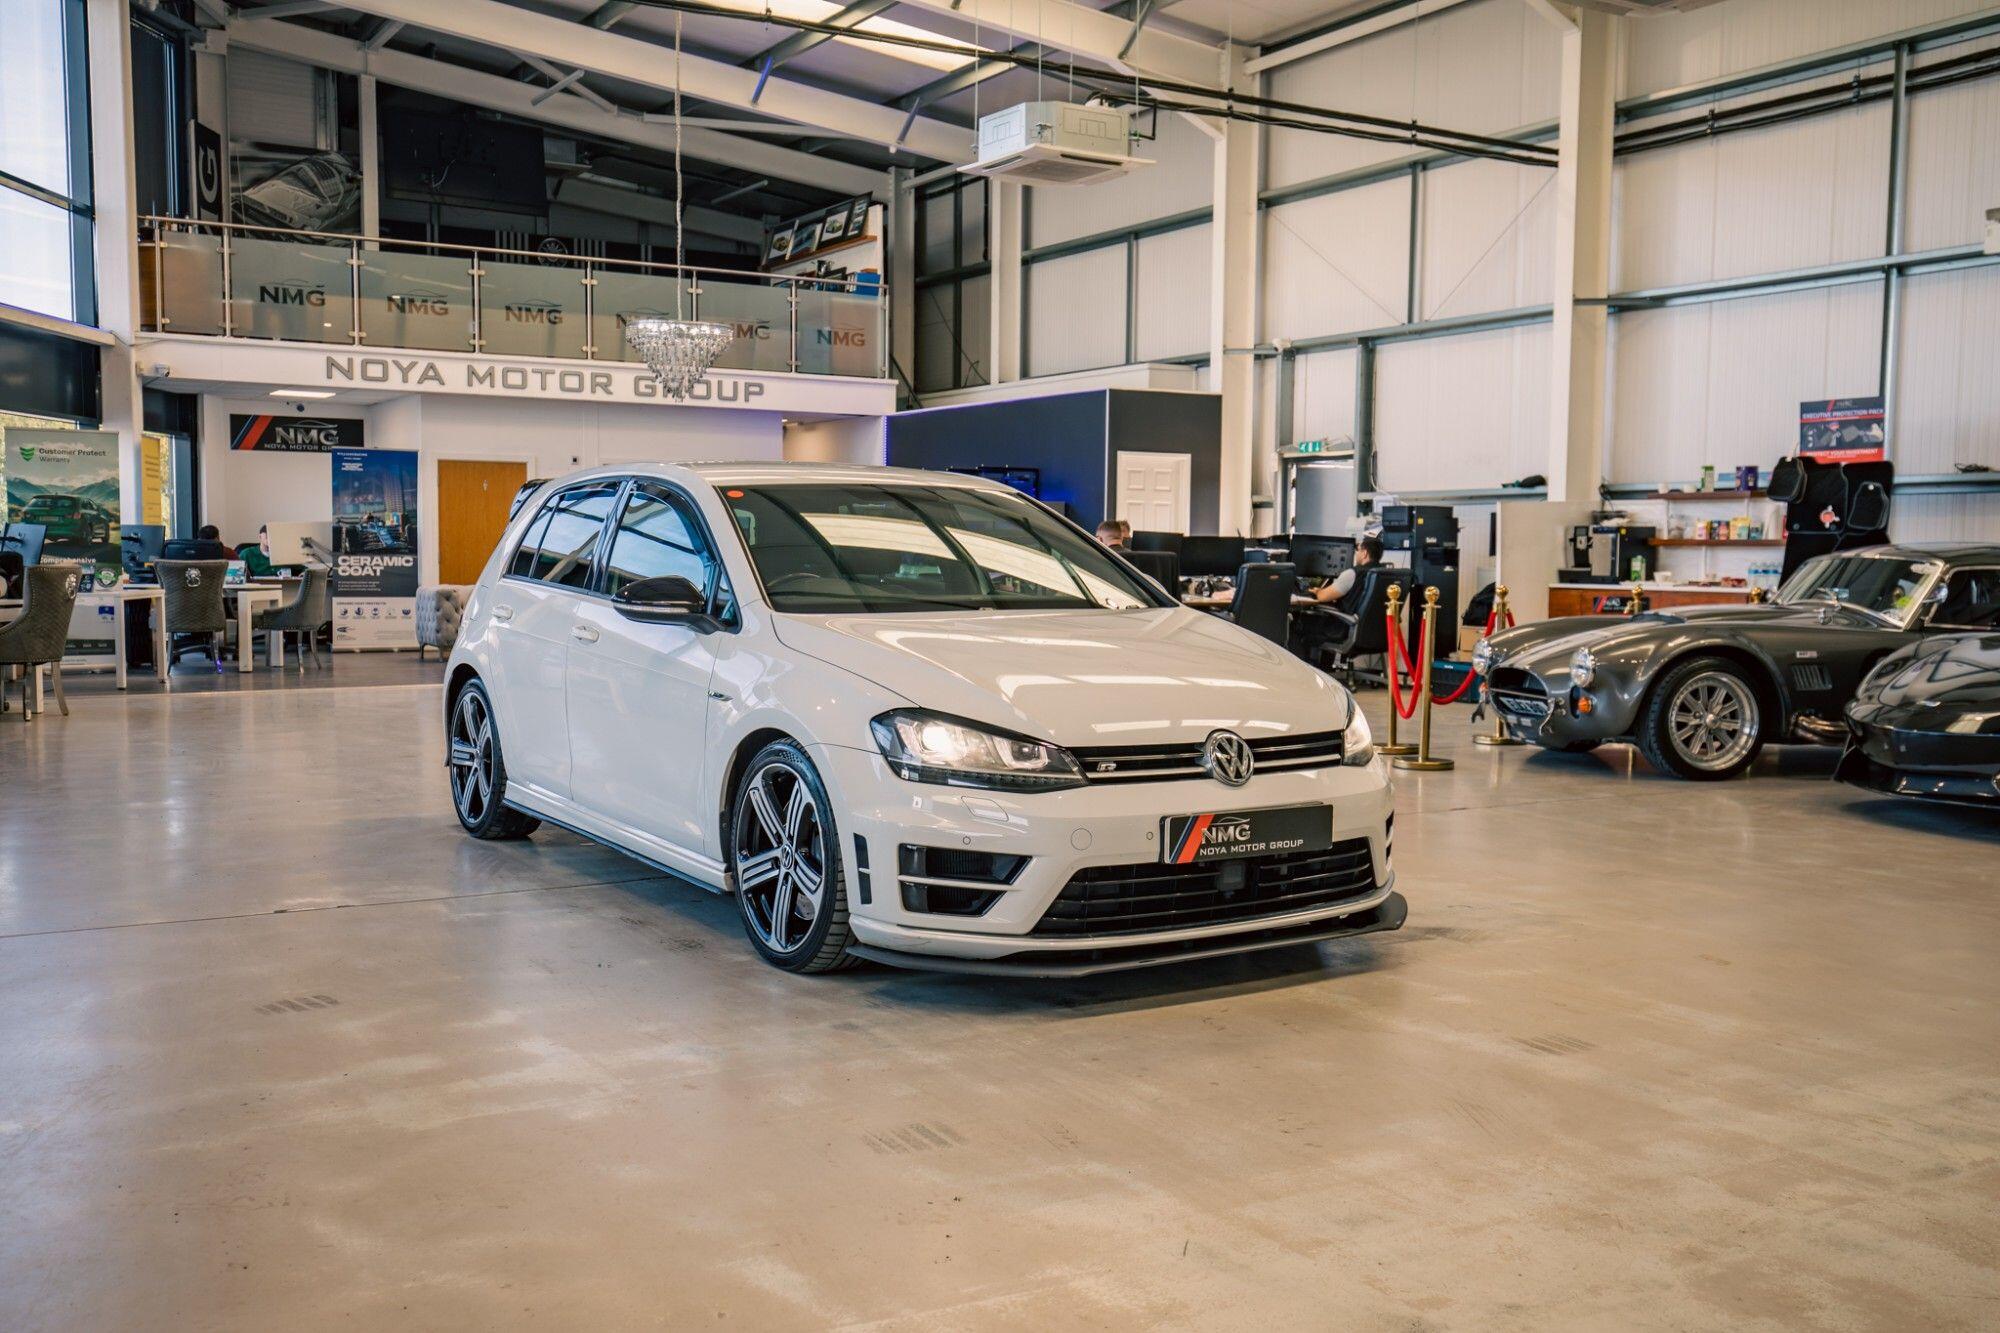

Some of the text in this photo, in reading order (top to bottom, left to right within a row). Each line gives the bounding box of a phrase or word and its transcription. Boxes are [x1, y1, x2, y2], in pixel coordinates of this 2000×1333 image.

[259, 285, 326, 307] NMG
[387, 295, 449, 316] NMG
[505, 305, 563, 324] NMG
[730, 323, 770, 340] MG
[816, 329, 866, 347] NMG
[326, 356, 765, 403] NOYA MOTOR GOUP
[275, 426, 339, 446] NMG
[39, 448, 107, 457] Customer Protect
[40, 456, 71, 464] Warranty
[337, 555, 414, 567] CERAMIC
[337, 566, 385, 577] COAT
[1201, 824, 1251, 845] NMG
[1200, 839, 1304, 856] NOYA MOTOR GROUP
